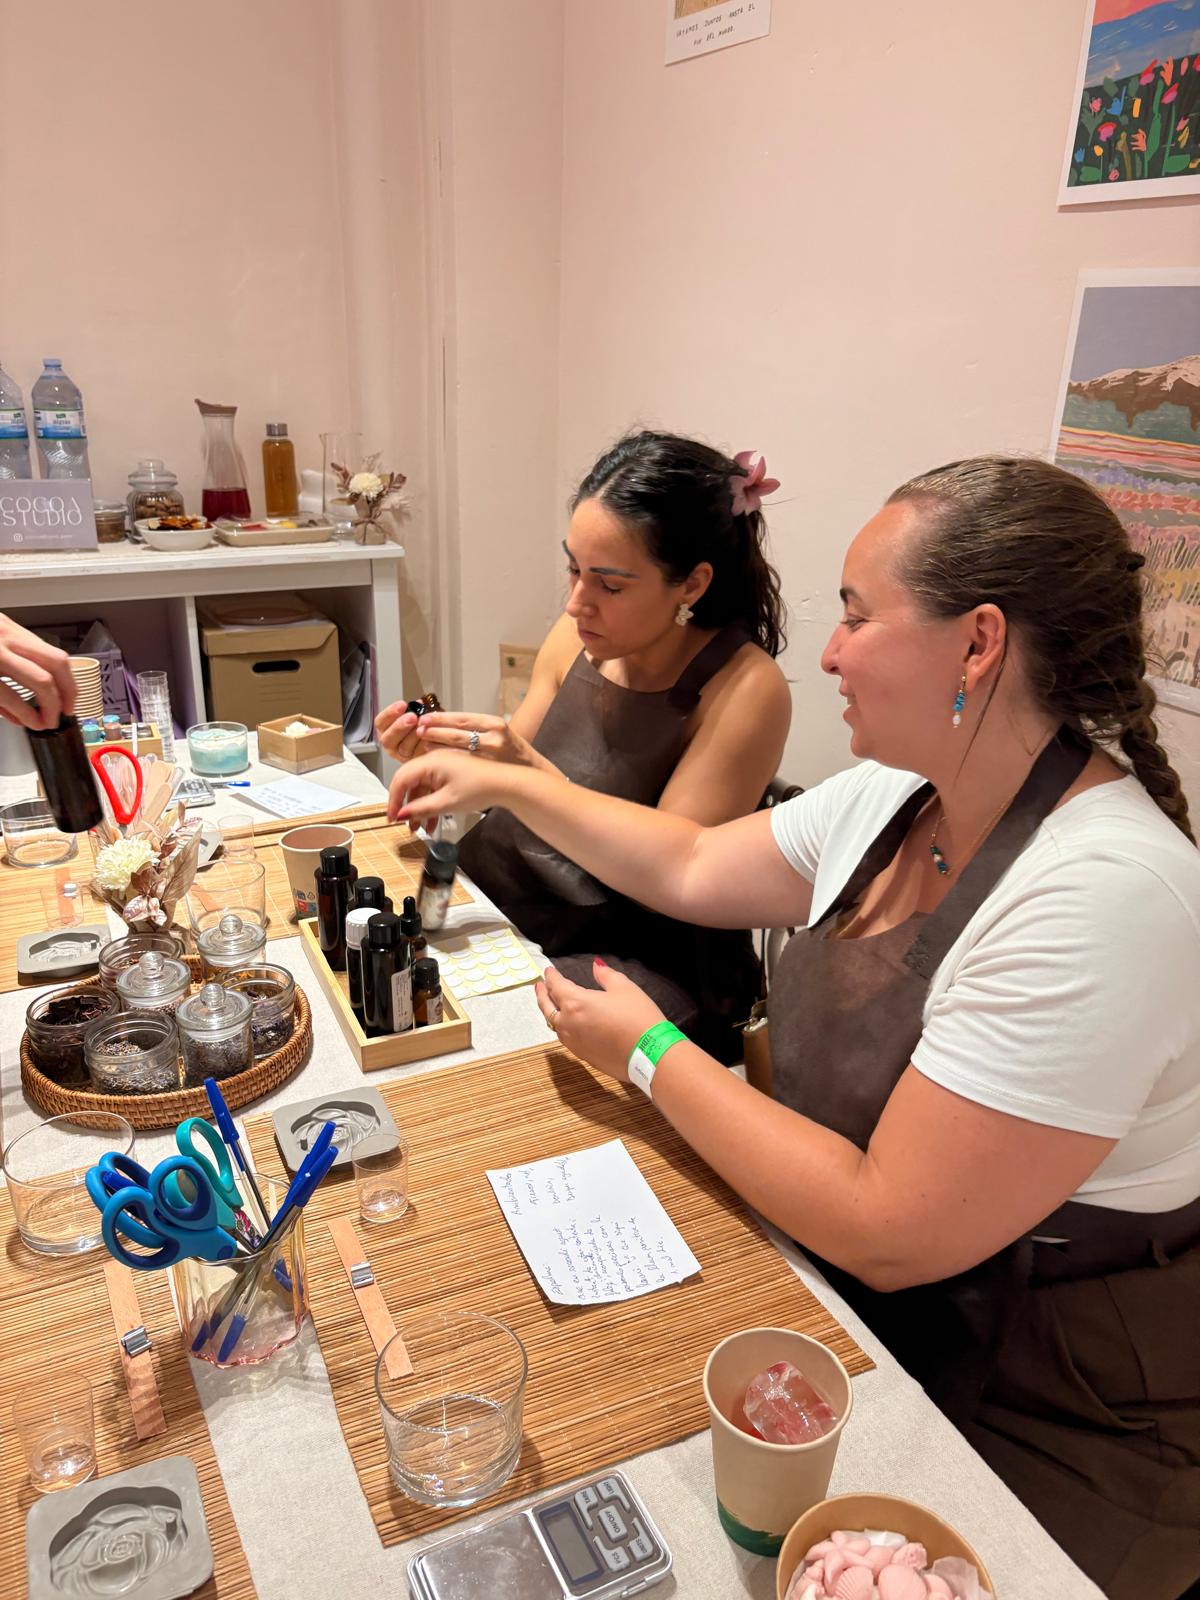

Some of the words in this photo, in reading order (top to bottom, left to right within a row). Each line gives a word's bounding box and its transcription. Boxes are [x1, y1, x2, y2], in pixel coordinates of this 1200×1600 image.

[2, 509, 84, 526] STUDIO
[580, 1491, 590, 1504] TARE
[605, 1511, 621, 1533] ON/OFF
[612, 1551, 622, 1564] PCS
